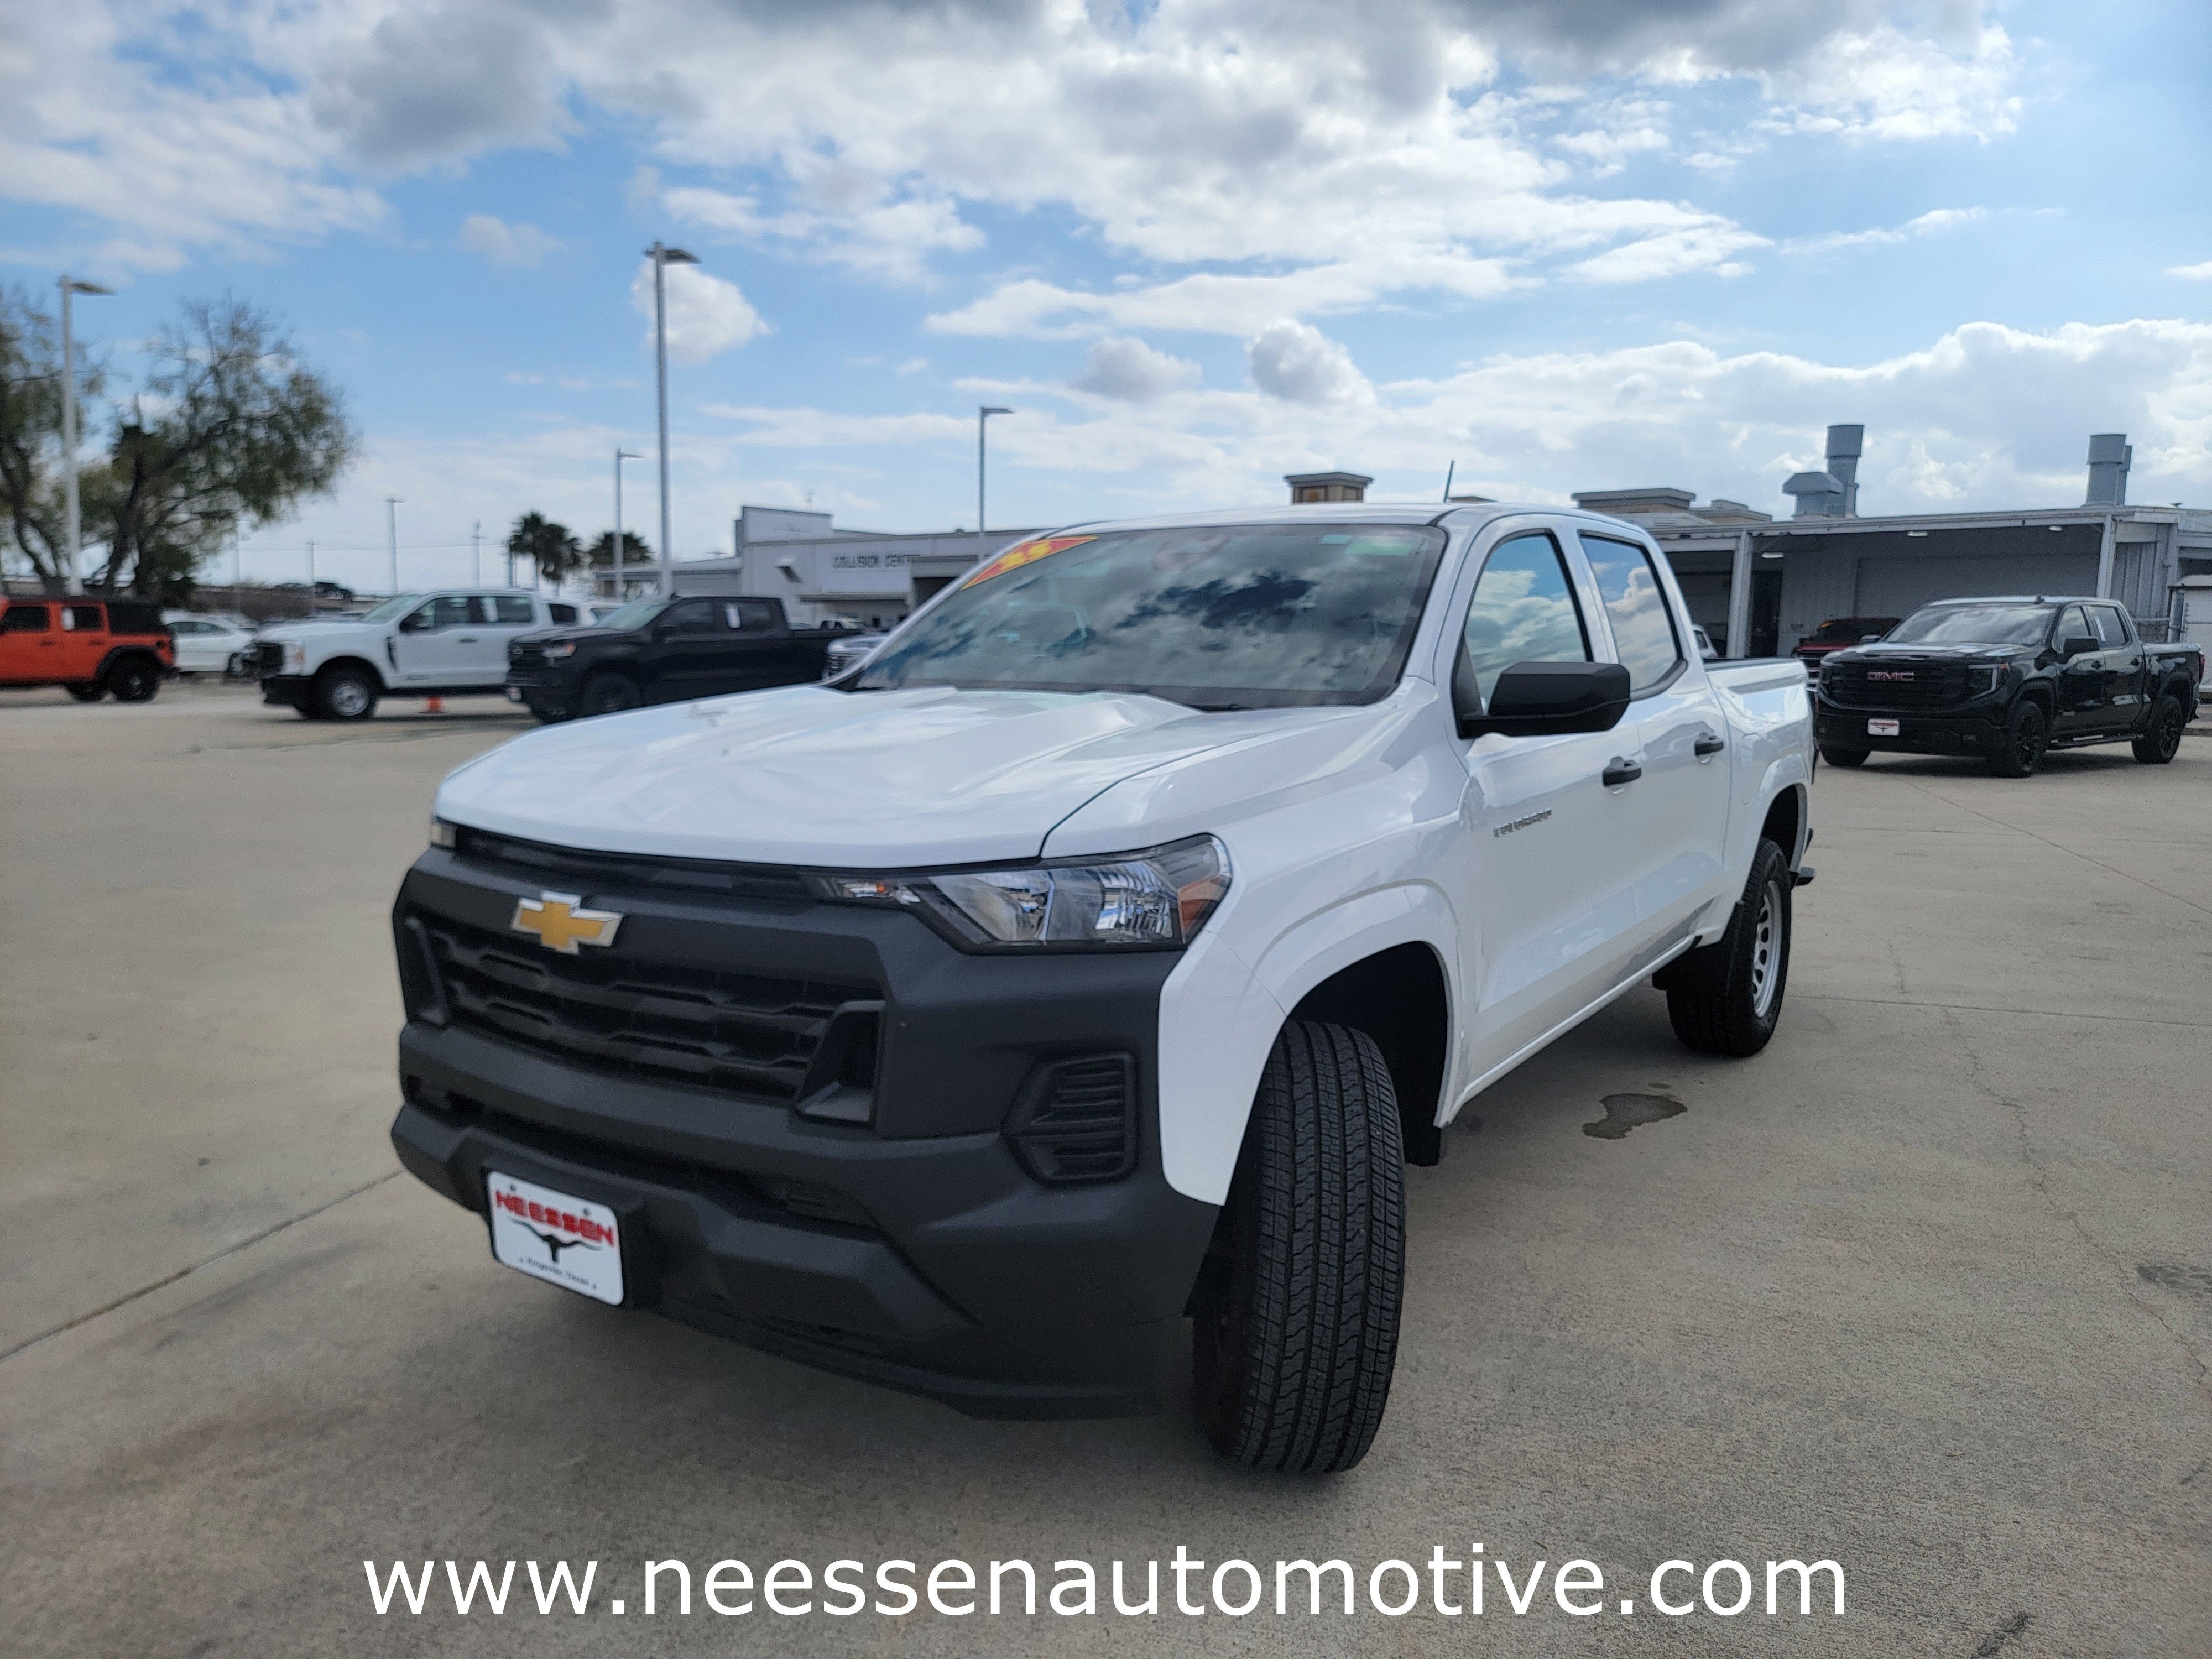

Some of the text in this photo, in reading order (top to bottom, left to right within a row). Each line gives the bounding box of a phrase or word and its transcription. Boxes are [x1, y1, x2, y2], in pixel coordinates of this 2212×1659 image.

[832, 555, 879, 568] COLLISION
[1866, 671, 1914, 682] GMC
[495, 1189, 615, 1248] NEESSEN
